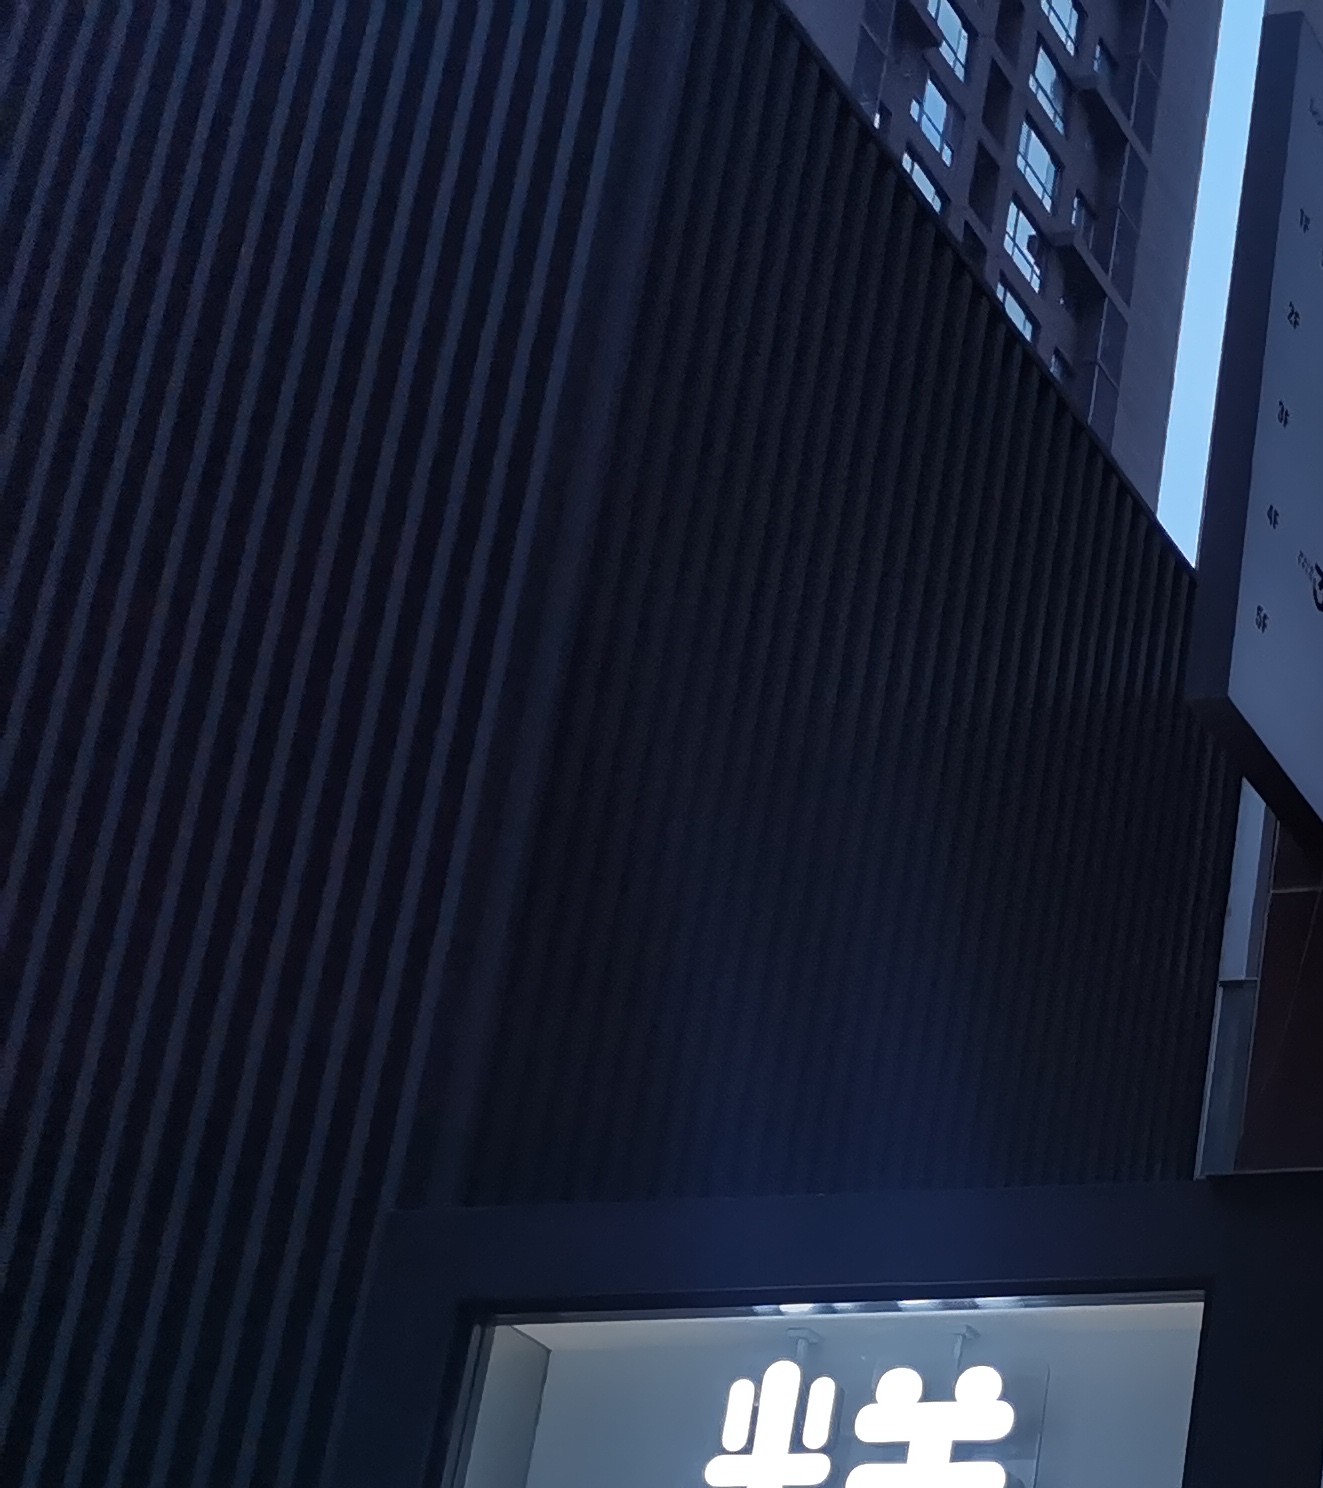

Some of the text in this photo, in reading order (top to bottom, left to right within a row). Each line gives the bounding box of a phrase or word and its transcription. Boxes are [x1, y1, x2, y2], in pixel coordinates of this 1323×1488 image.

[1286, 300, 1301, 330] 2F
[1266, 503, 1280, 530] 4F
[1255, 604, 1270, 634] 5F
